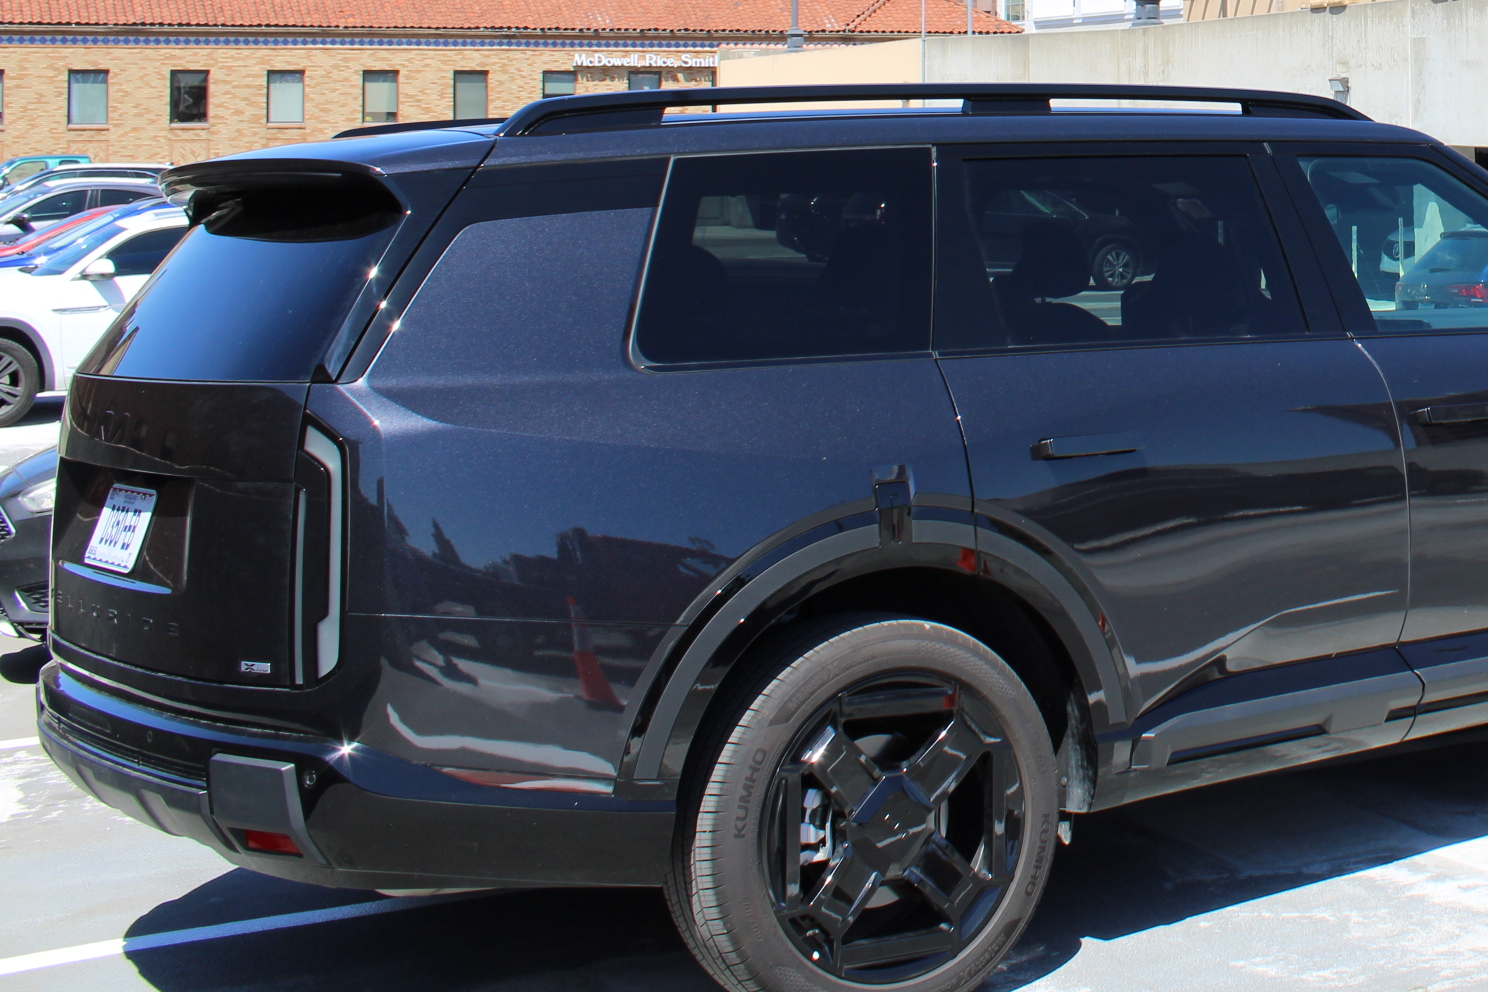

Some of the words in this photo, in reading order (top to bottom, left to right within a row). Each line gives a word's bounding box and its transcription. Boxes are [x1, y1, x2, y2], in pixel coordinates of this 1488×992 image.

[573, 53, 642, 68] McDowell,
[645, 53, 678, 68] Rice,
[733, 748, 768, 840] KUMHO
[1025, 811, 1052, 898] KUMHO
